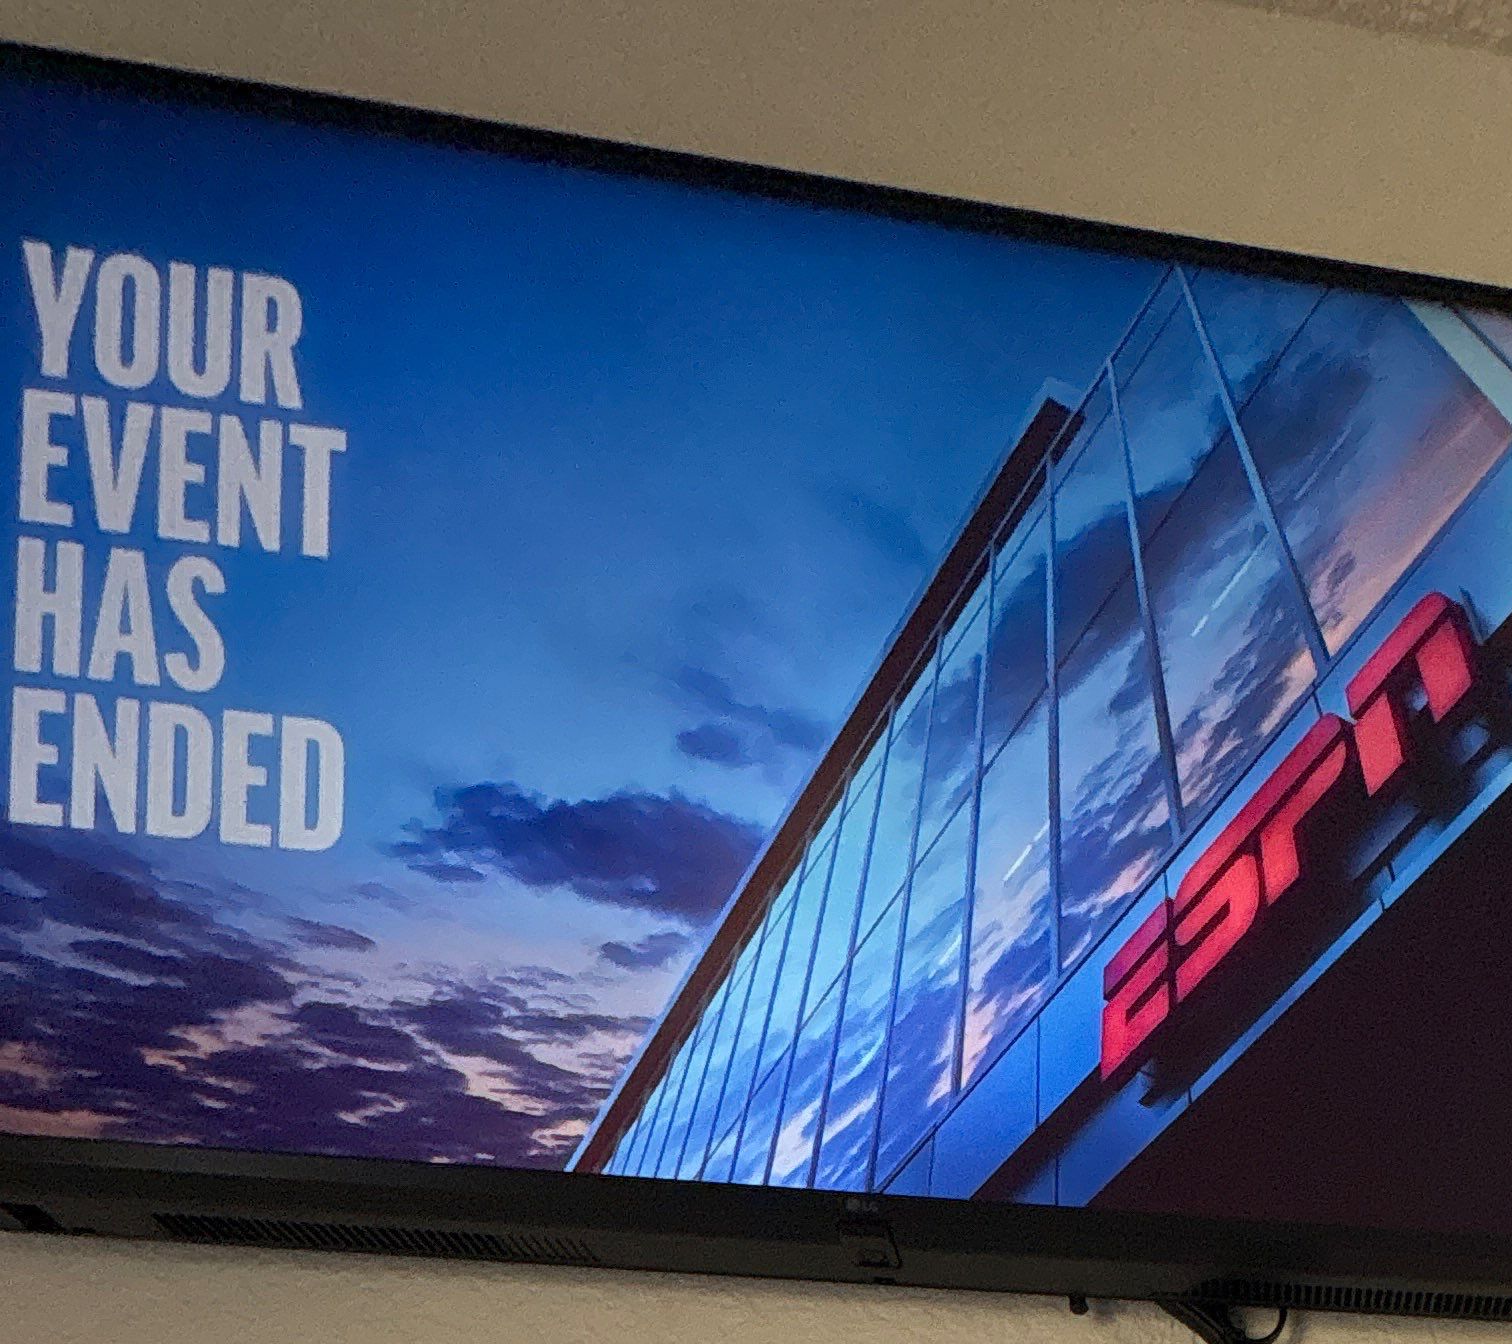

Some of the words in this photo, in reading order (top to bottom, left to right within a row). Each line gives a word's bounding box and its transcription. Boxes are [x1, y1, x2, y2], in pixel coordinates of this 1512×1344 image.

[22, 239, 303, 410] YOUR
[18, 390, 347, 558] EVENT
[14, 538, 226, 692] HAS
[8, 687, 345, 852] ENDED
[1100, 591, 1479, 1082] ESPN
